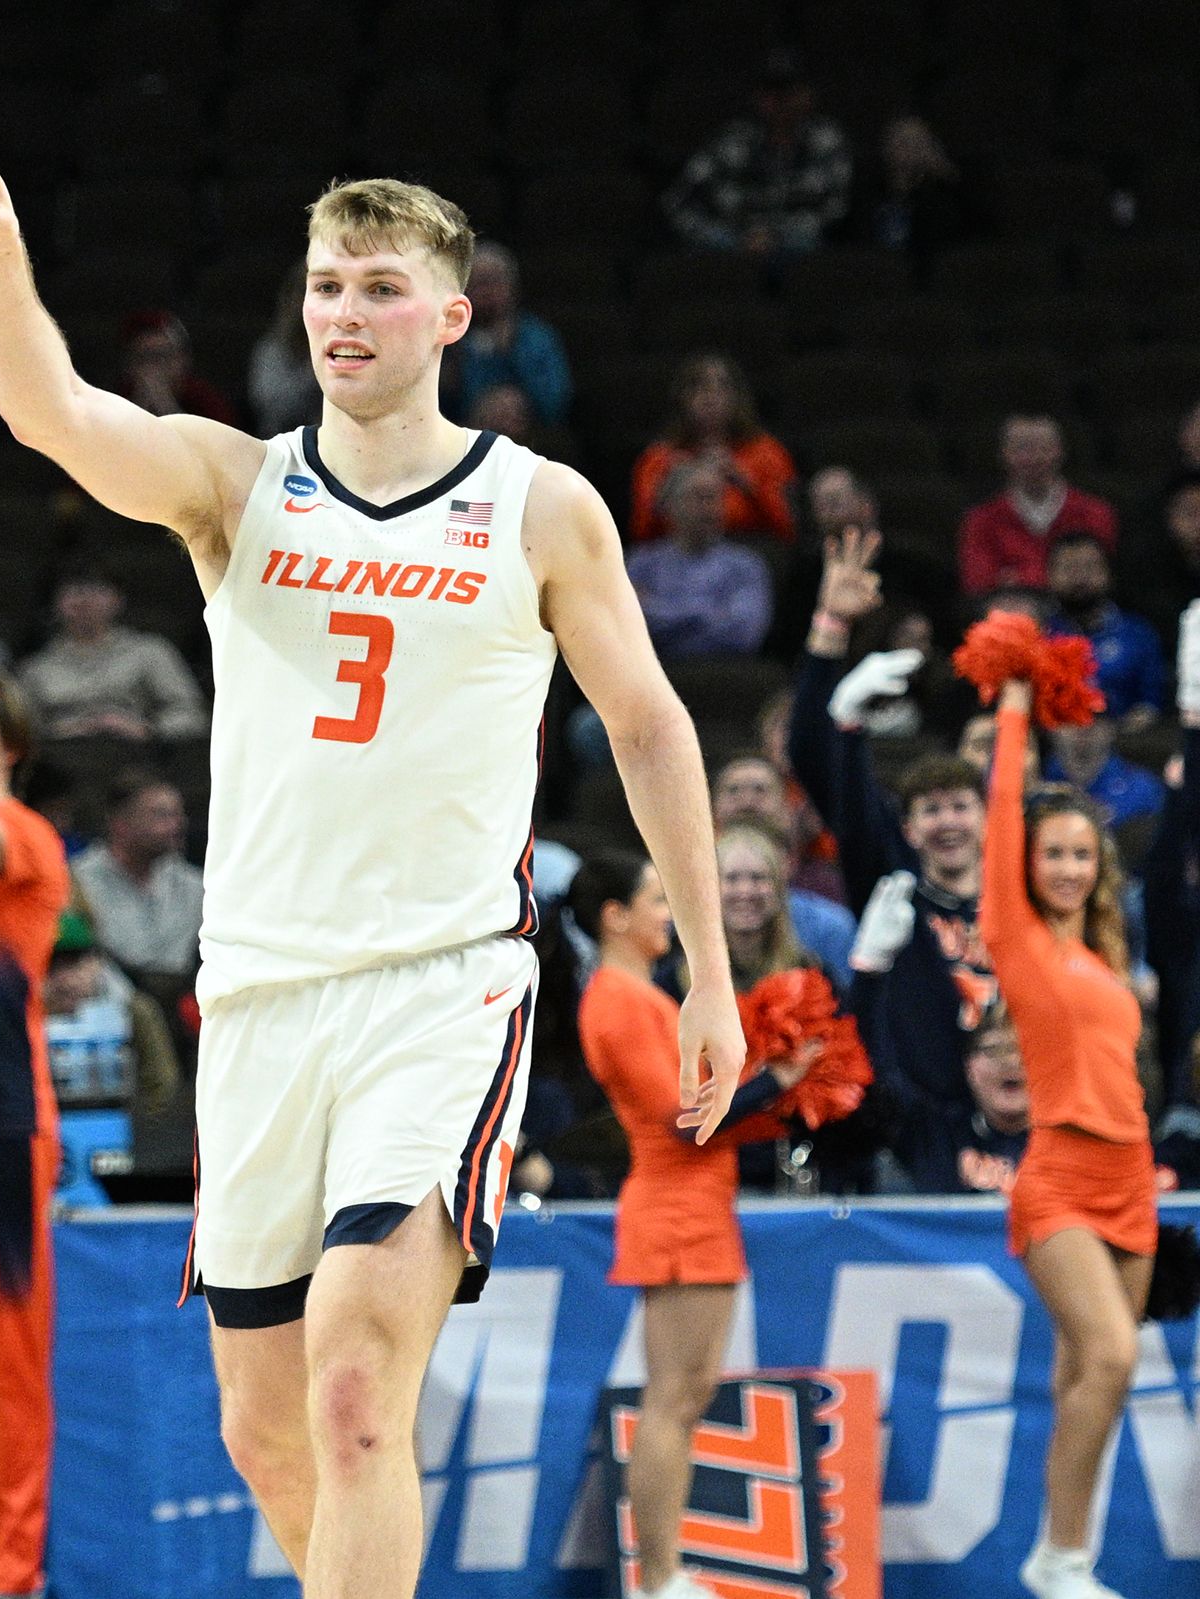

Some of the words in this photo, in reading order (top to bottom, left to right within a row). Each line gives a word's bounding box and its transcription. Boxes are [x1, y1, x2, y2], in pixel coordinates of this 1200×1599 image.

[286, 481, 315, 493] NCAA
[261, 549, 487, 605] ILLINOIS
[312, 611, 394, 744] 3
